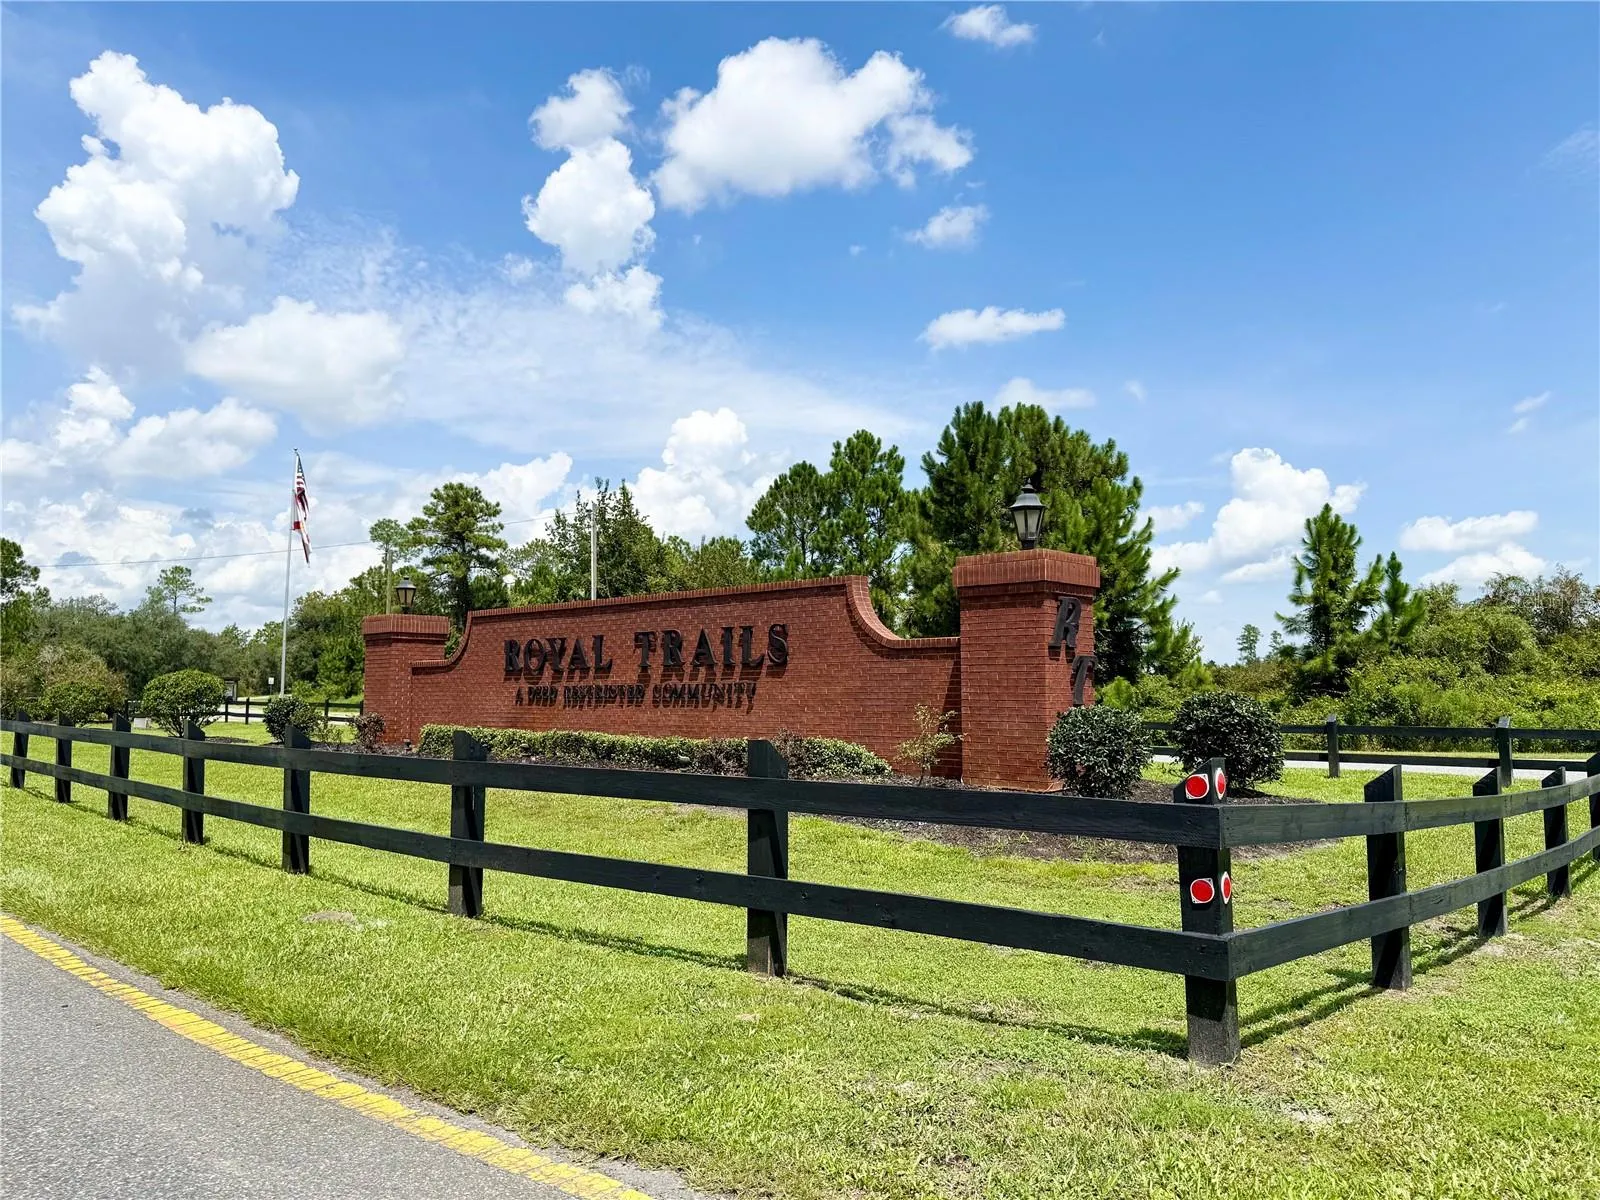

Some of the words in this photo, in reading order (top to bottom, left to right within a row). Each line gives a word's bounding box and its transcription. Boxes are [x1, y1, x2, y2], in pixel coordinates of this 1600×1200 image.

[1048, 596, 1081, 647] R
[504, 634, 613, 673] ROYAL
[633, 623, 789, 668] TRAILS
[527, 684, 558, 701] DEED
[564, 684, 645, 701] RESTRICTED
[652, 682, 757, 703] COMMUNITY
